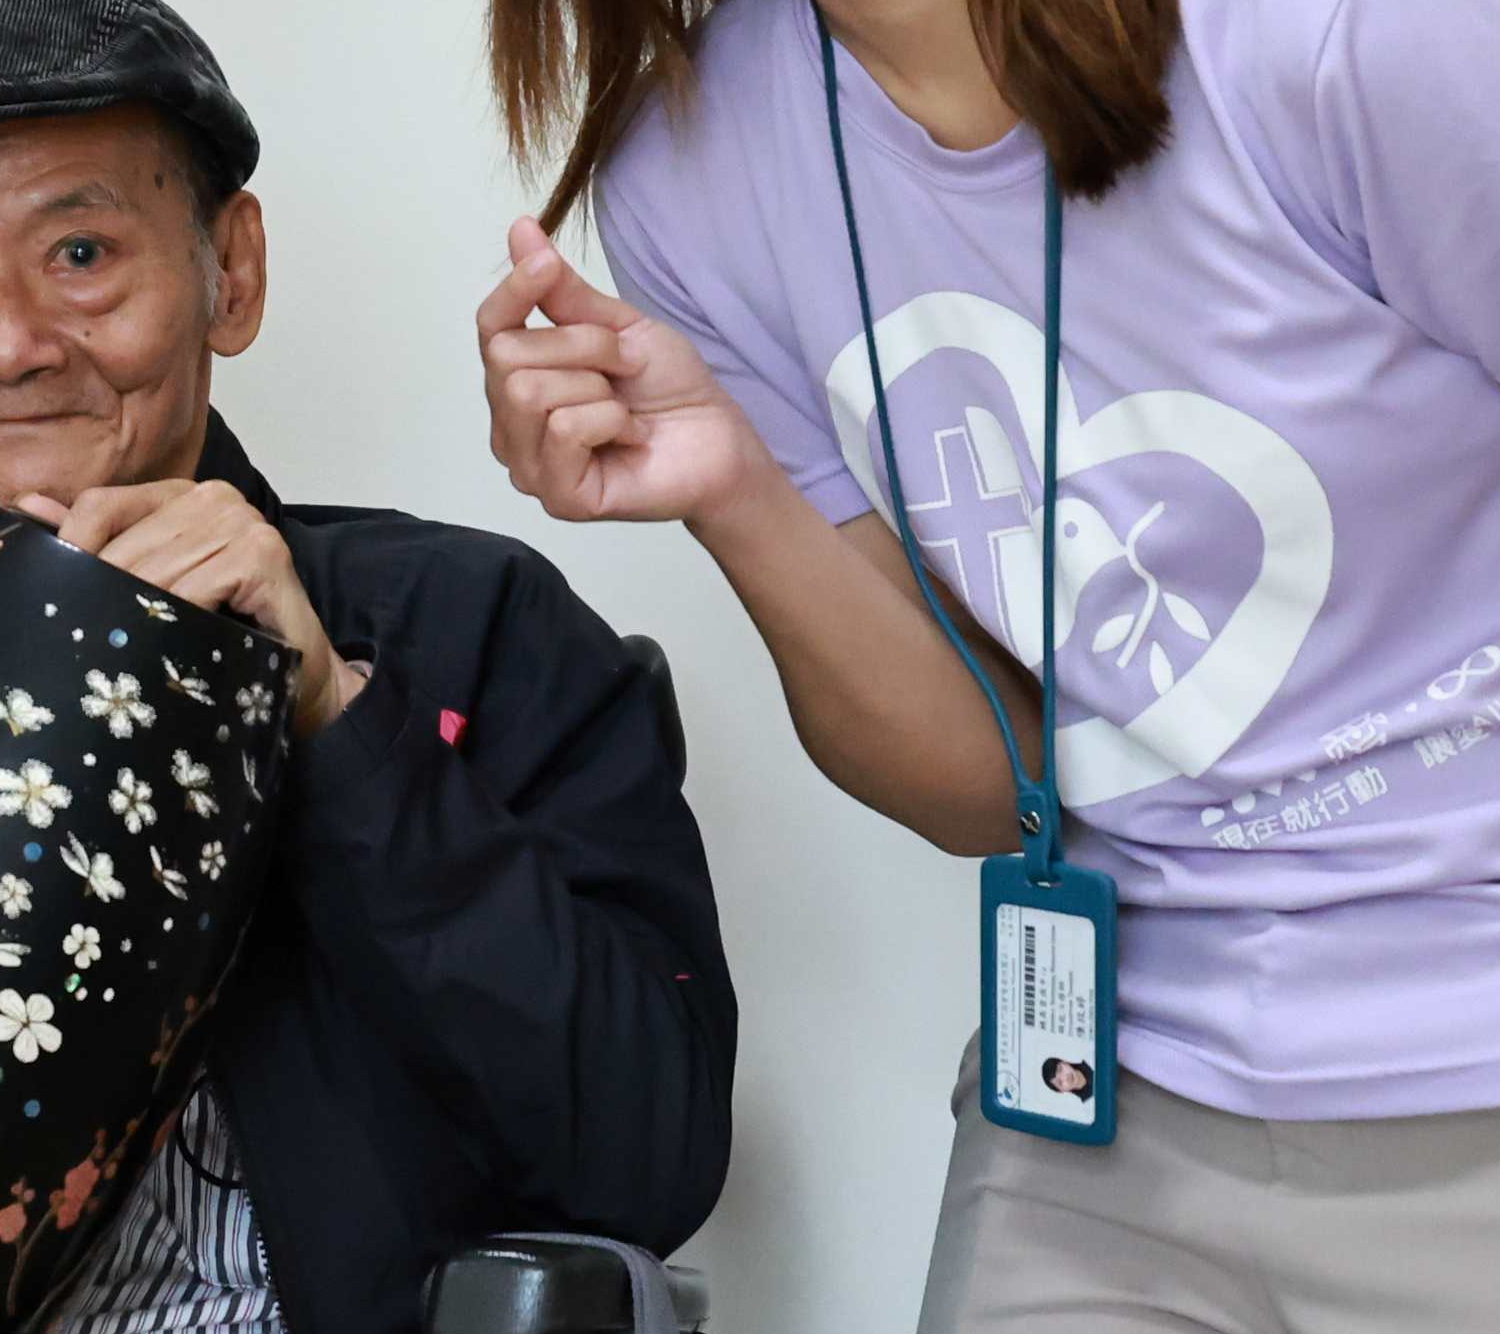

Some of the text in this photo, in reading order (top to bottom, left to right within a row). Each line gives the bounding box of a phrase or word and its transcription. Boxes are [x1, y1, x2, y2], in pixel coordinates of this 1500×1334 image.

[1212, 766, 1389, 850] 現在就行動
